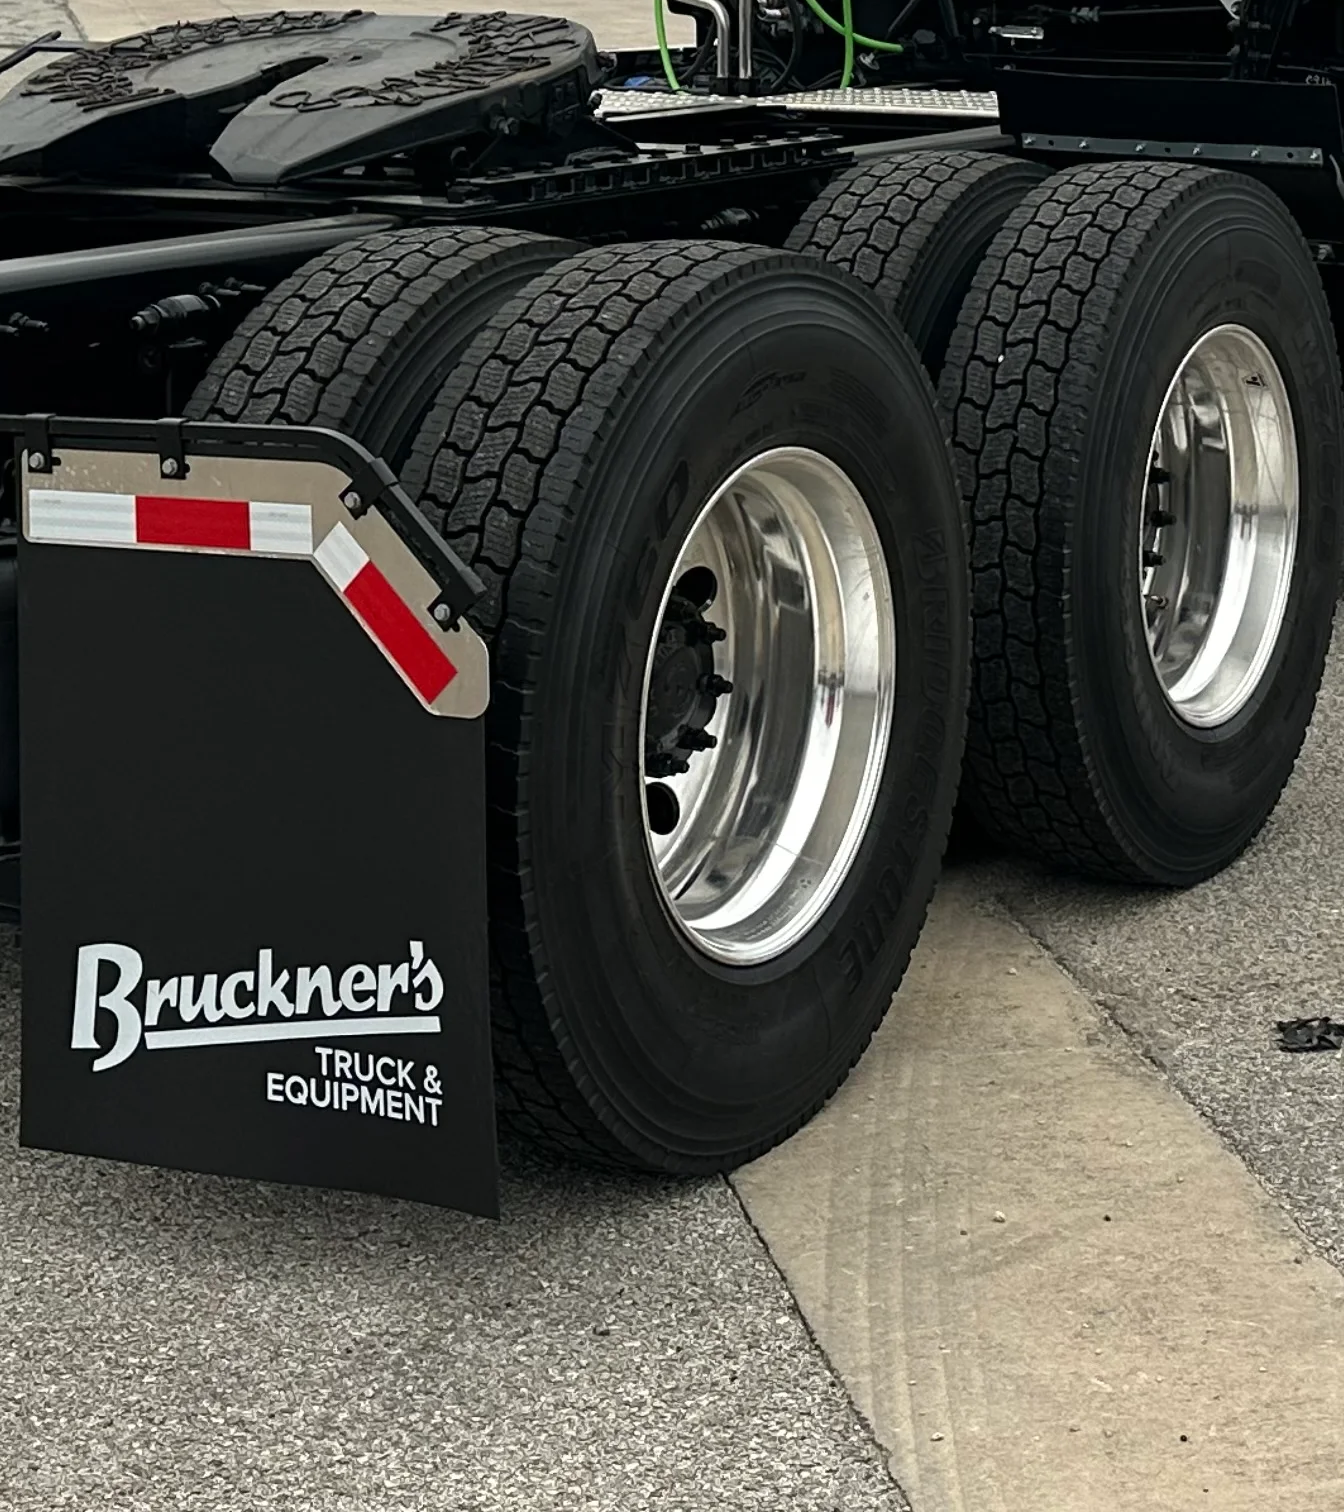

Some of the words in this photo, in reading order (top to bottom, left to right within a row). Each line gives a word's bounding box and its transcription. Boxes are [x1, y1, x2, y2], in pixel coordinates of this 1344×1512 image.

[70, 940, 444, 1072] Bruckner's
[314, 1046, 416, 1090] TRUCK
[423, 1064, 443, 1095] &
[266, 1072, 443, 1127] EQUIPMENT
